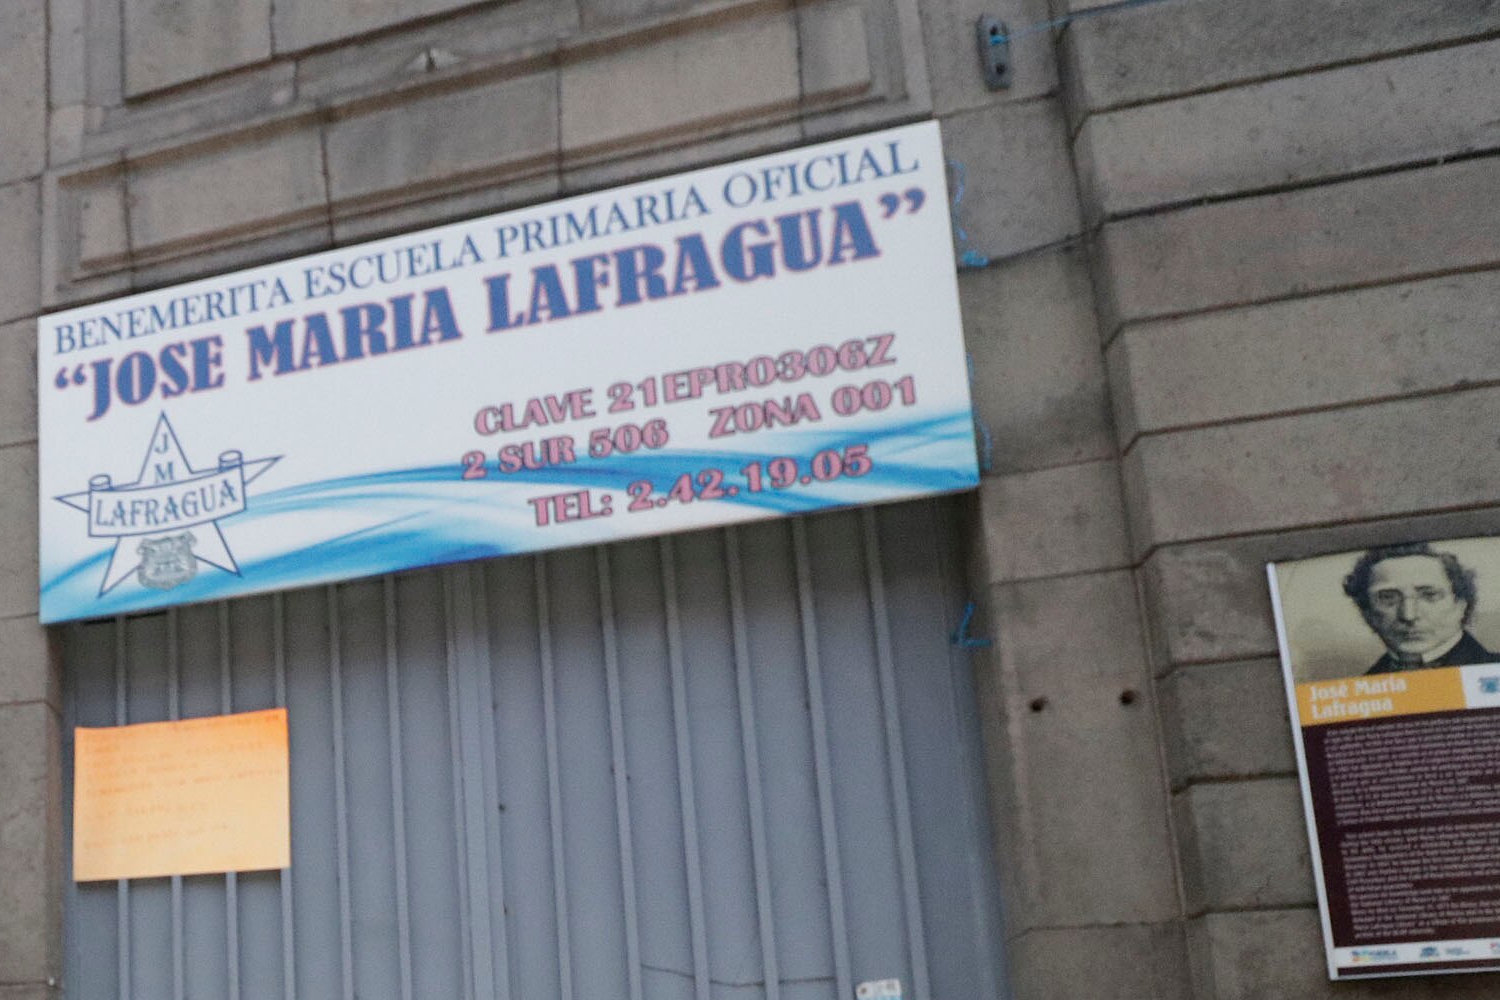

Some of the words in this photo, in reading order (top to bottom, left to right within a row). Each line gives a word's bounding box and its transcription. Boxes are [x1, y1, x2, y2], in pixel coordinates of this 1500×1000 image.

[54, 276, 293, 355] BENEMERITA
[303, 233, 483, 299] ESCUELA
[495, 185, 711, 259] PRIMARIA
[722, 140, 920, 210] OFICIAL
[54, 335, 227, 423] “JOSE
[246, 286, 464, 383] MARIA
[483, 187, 927, 334] LAFRAGUA”
[155, 433, 169, 455] J
[461, 450, 488, 482] 2
[499, 434, 576, 475] SUR
[588, 418, 670, 460] 506
[708, 393, 821, 439] ZONA
[832, 375, 917, 417] 001
[474, 388, 597, 437] CLAVE
[95, 479, 238, 528] LAFRAGUA
[155, 461, 175, 484] M
[528, 489, 614, 527] TEL:
[627, 444, 874, 512] 2.42.19.05
